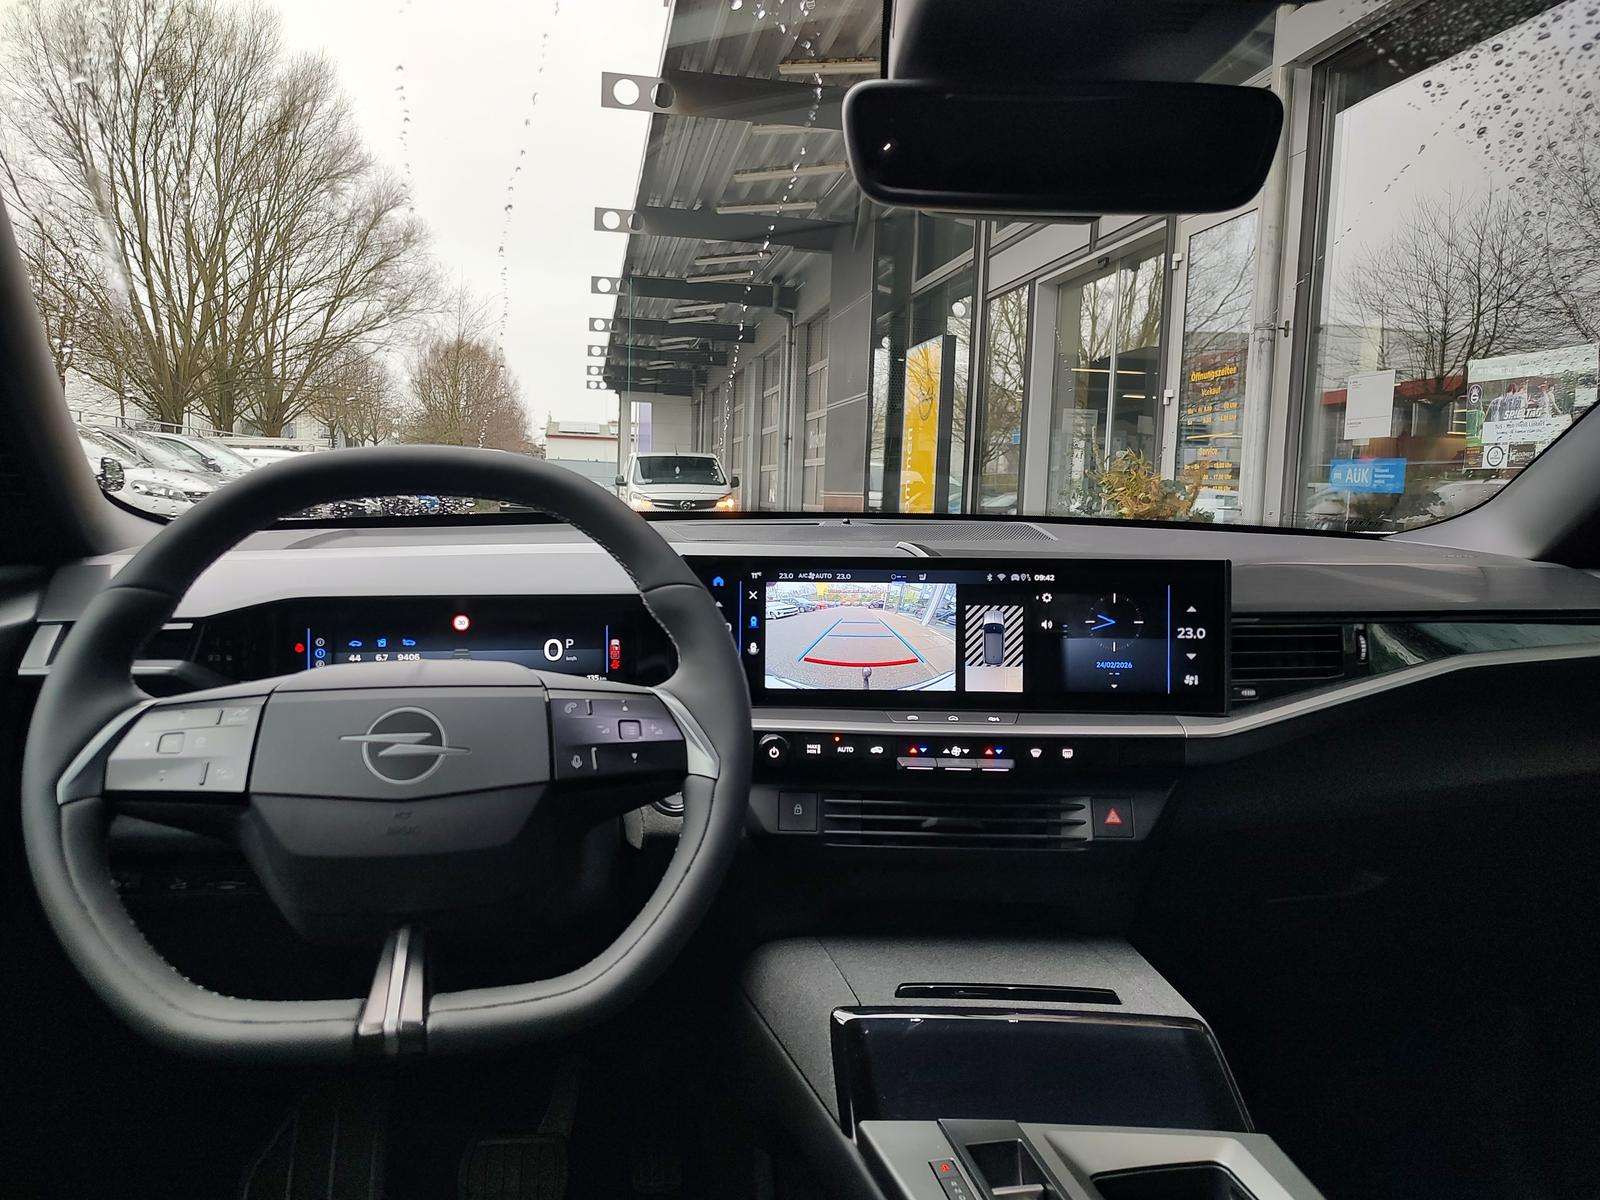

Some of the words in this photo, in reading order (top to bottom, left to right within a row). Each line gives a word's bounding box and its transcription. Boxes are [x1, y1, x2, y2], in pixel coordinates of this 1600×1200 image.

[778, 572, 794, 580] 23.0
[1034, 574, 1055, 582] 09:42
[1176, 627, 1206, 640] 23.0
[543, 638, 564, 662] 0
[565, 638, 574, 649] P
[375, 654, 389, 662] 6.7
[1096, 661, 1133, 669] 24/02/2026
